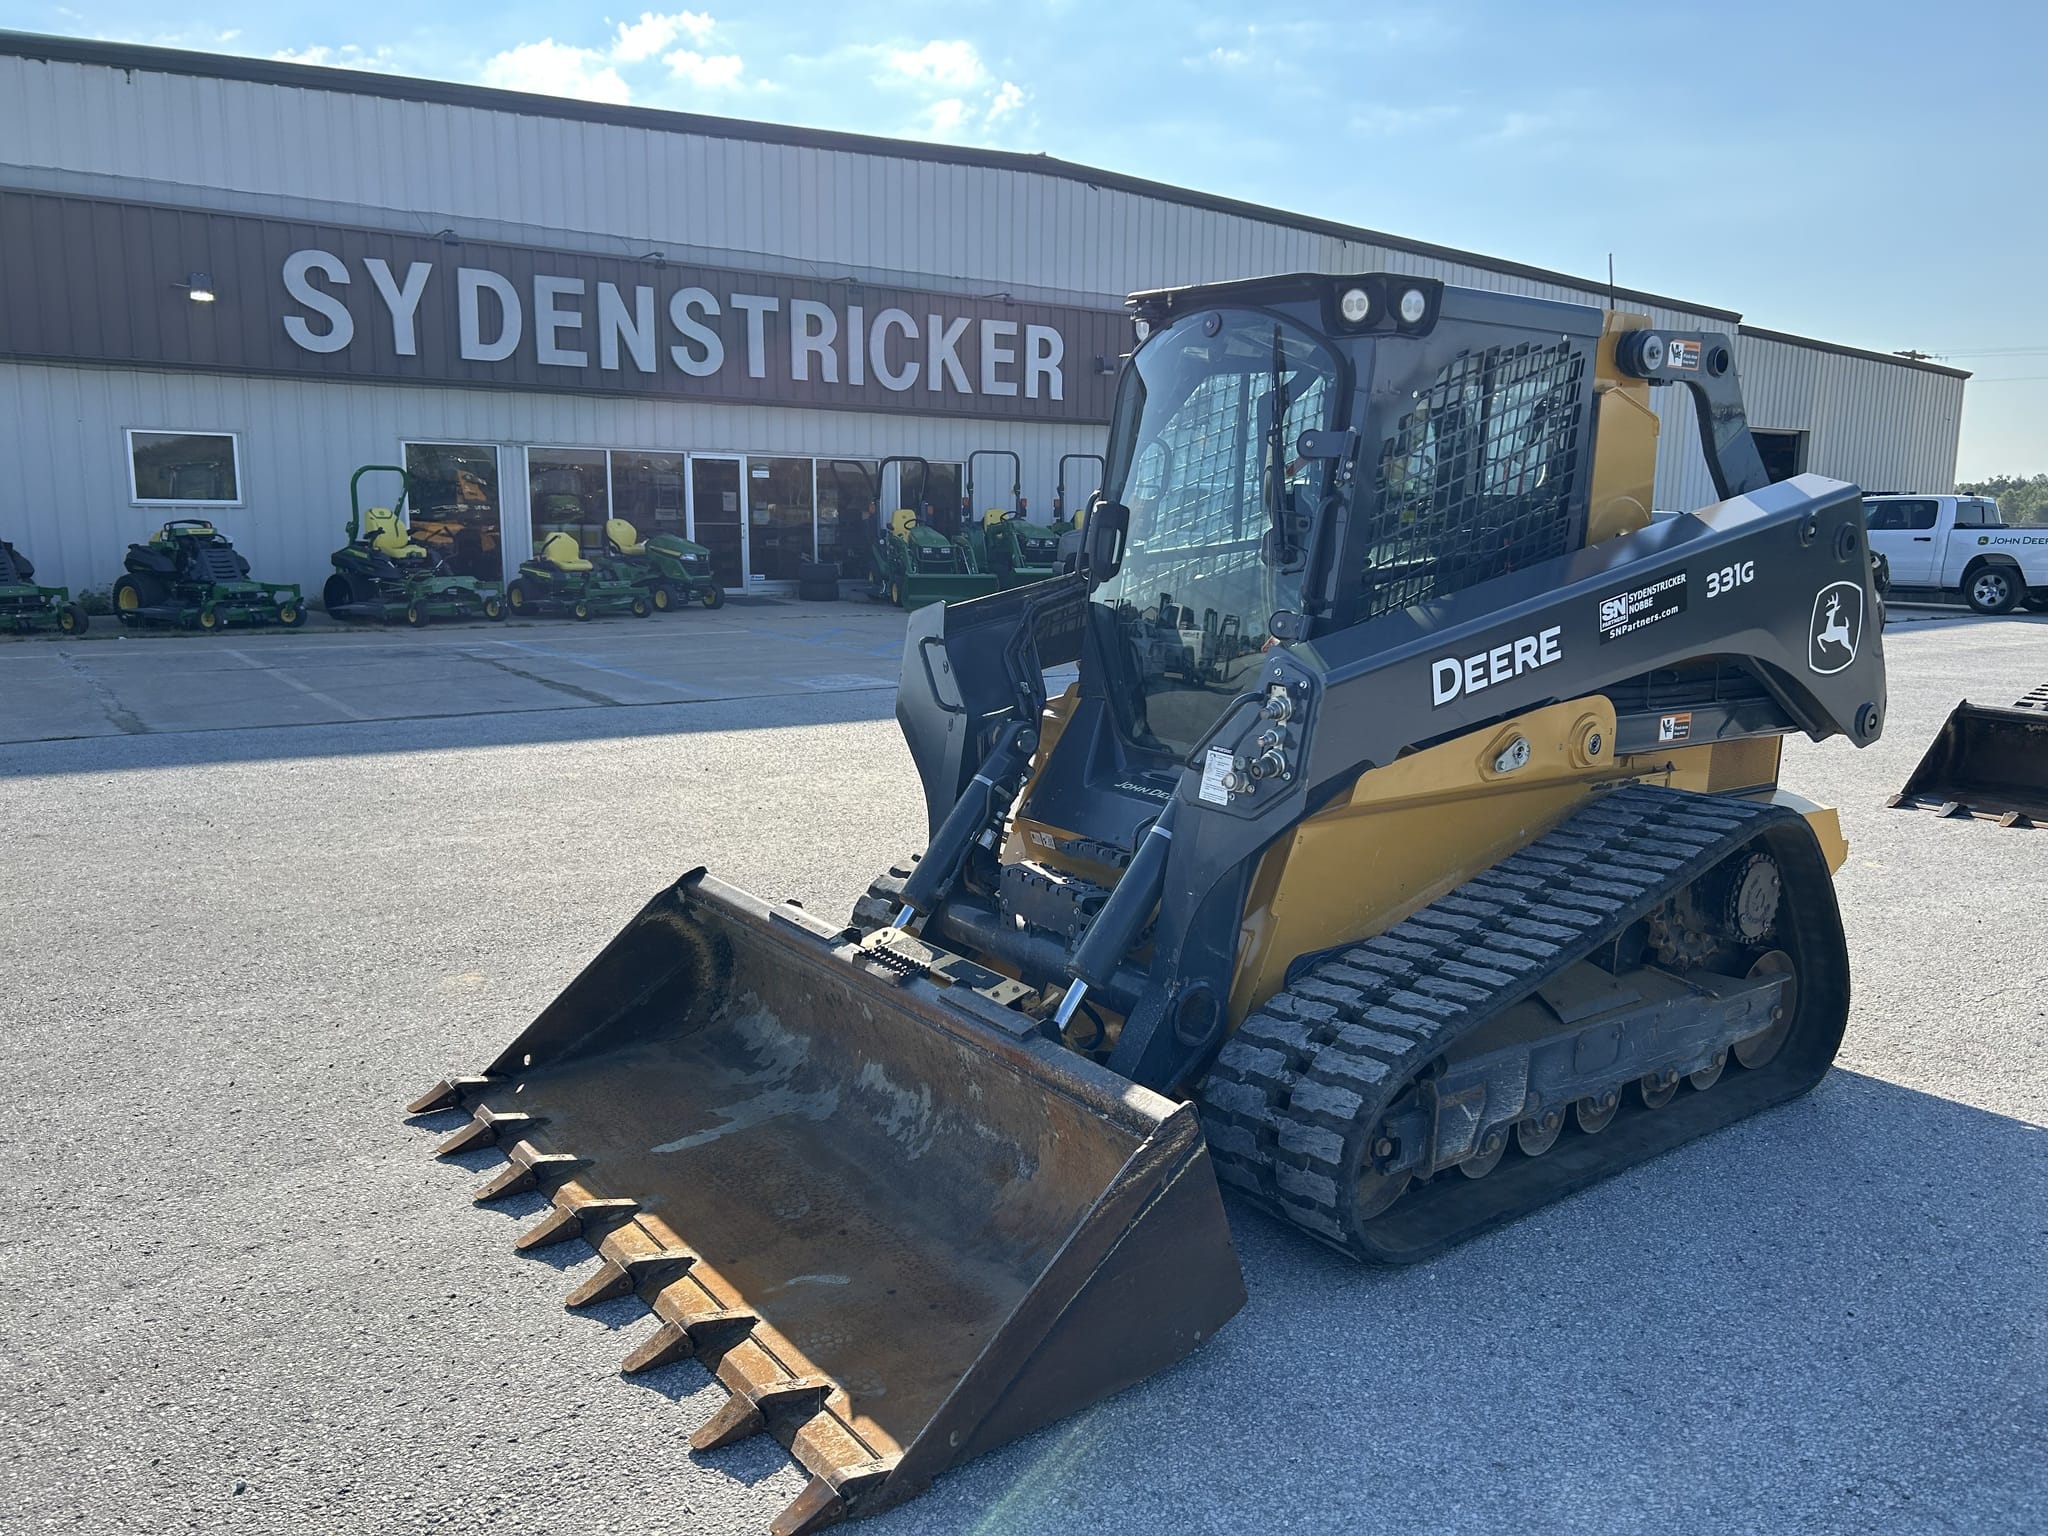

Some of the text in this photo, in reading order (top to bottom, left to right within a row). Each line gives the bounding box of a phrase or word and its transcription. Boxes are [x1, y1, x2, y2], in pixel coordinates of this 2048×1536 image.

[282, 248, 1065, 401] SYDENSTRICKER
[1990, 536, 2021, 545] JOHN
[1628, 573, 1687, 603] SYDENSTRICKER
[1706, 560, 1754, 598] 331G
[1602, 597, 1626, 621] SN
[1629, 597, 1654, 615] NOBBE
[1609, 605, 1679, 639] SNPartners.com
[1432, 625, 1562, 706] DEERE
[1114, 781, 1151, 793] JOHN
